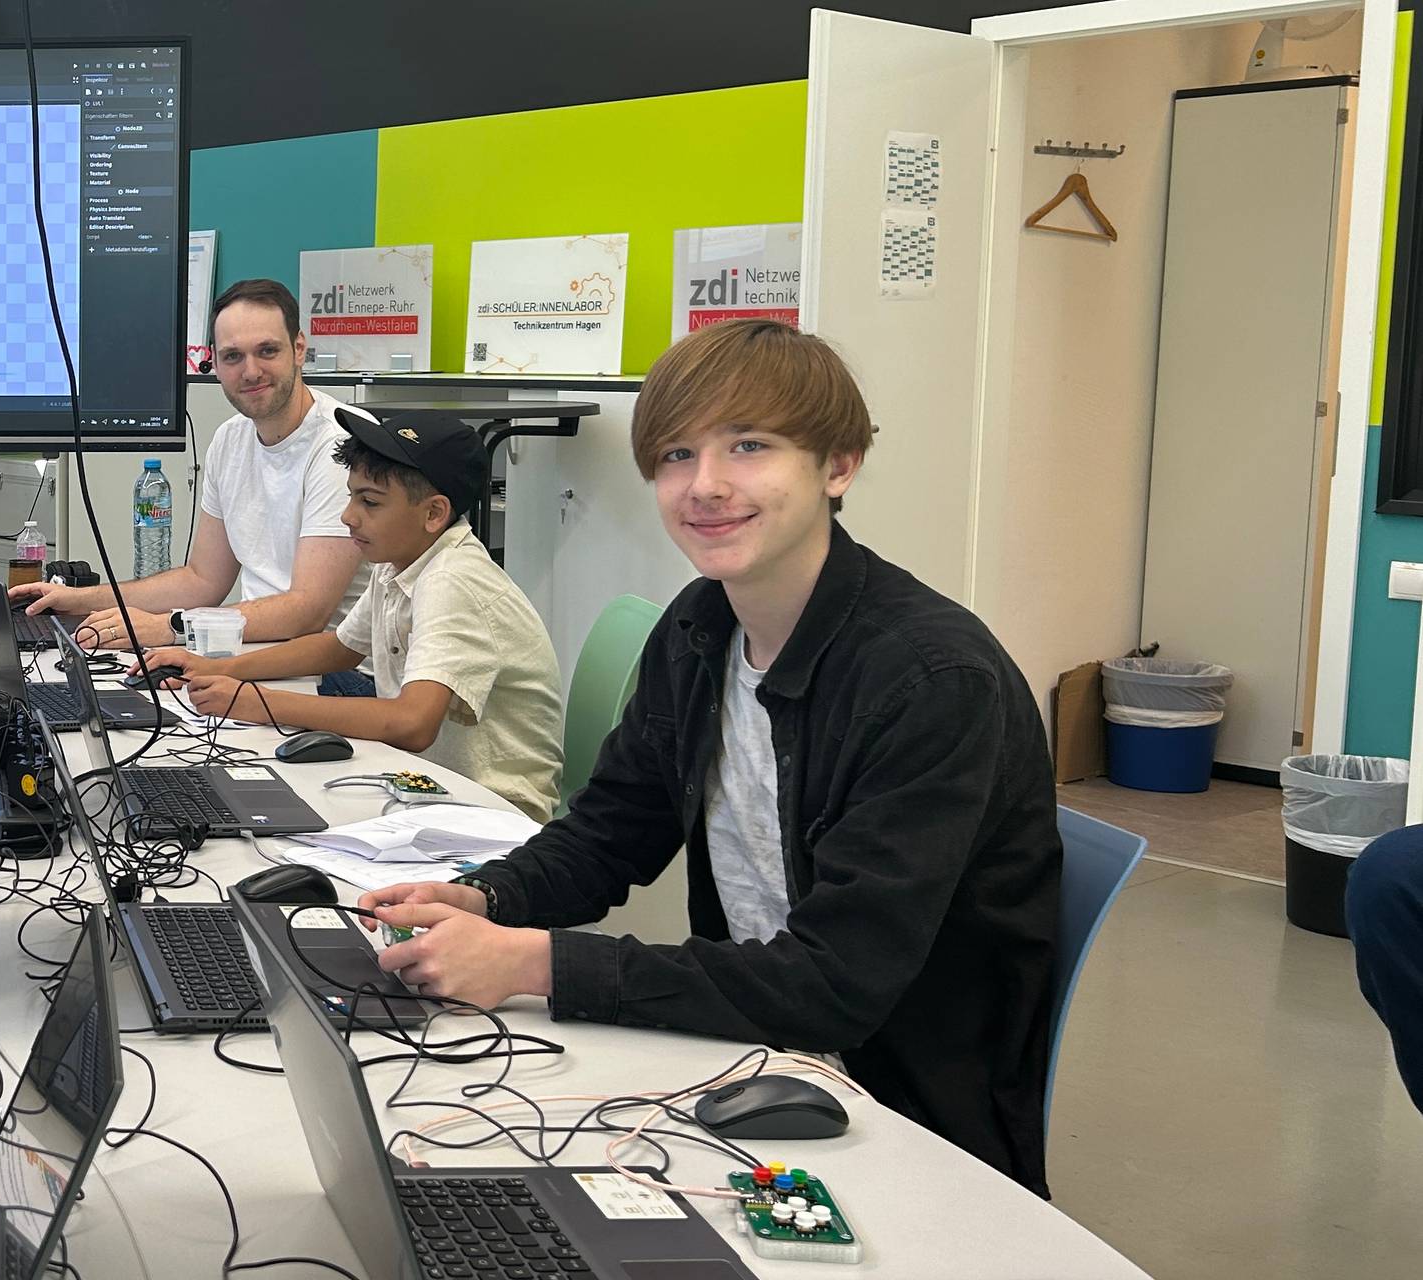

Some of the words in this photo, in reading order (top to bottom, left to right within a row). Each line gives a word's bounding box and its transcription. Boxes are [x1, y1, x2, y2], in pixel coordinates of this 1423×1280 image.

[348, 283, 395, 297] Netzwerk
[689, 269, 738, 306] zdi
[311, 285, 344, 314] zdi
[348, 299, 415, 315] Ennepe-Ruhr
[477, 301, 603, 314] zdi-SCHÜLER:INNENLABOR
[312, 318, 417, 333] Nordrhein-Westfalen
[513, 321, 574, 331] Technikzentrum
[575, 320, 601, 332] Hagen
